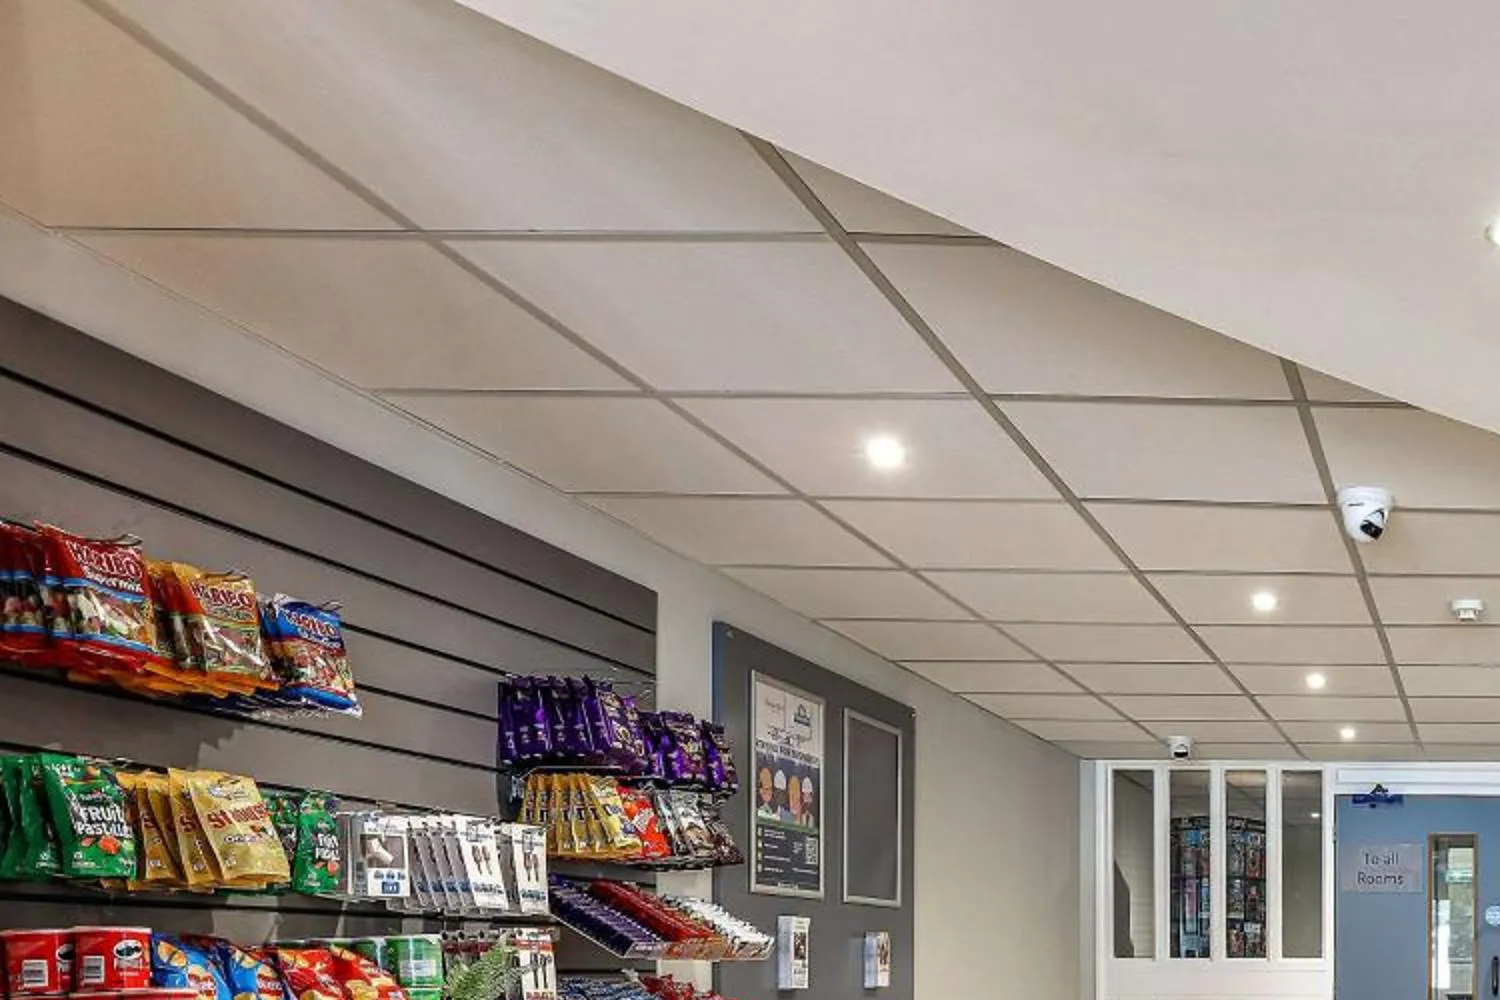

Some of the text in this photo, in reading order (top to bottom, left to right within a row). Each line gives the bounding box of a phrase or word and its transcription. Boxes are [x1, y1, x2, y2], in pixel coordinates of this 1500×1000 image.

[65, 541, 143, 579] HARIBO
[190, 580, 251, 607] HARIBO
[1364, 851, 1399, 865] To all
[1357, 870, 1404, 885] Rooms
